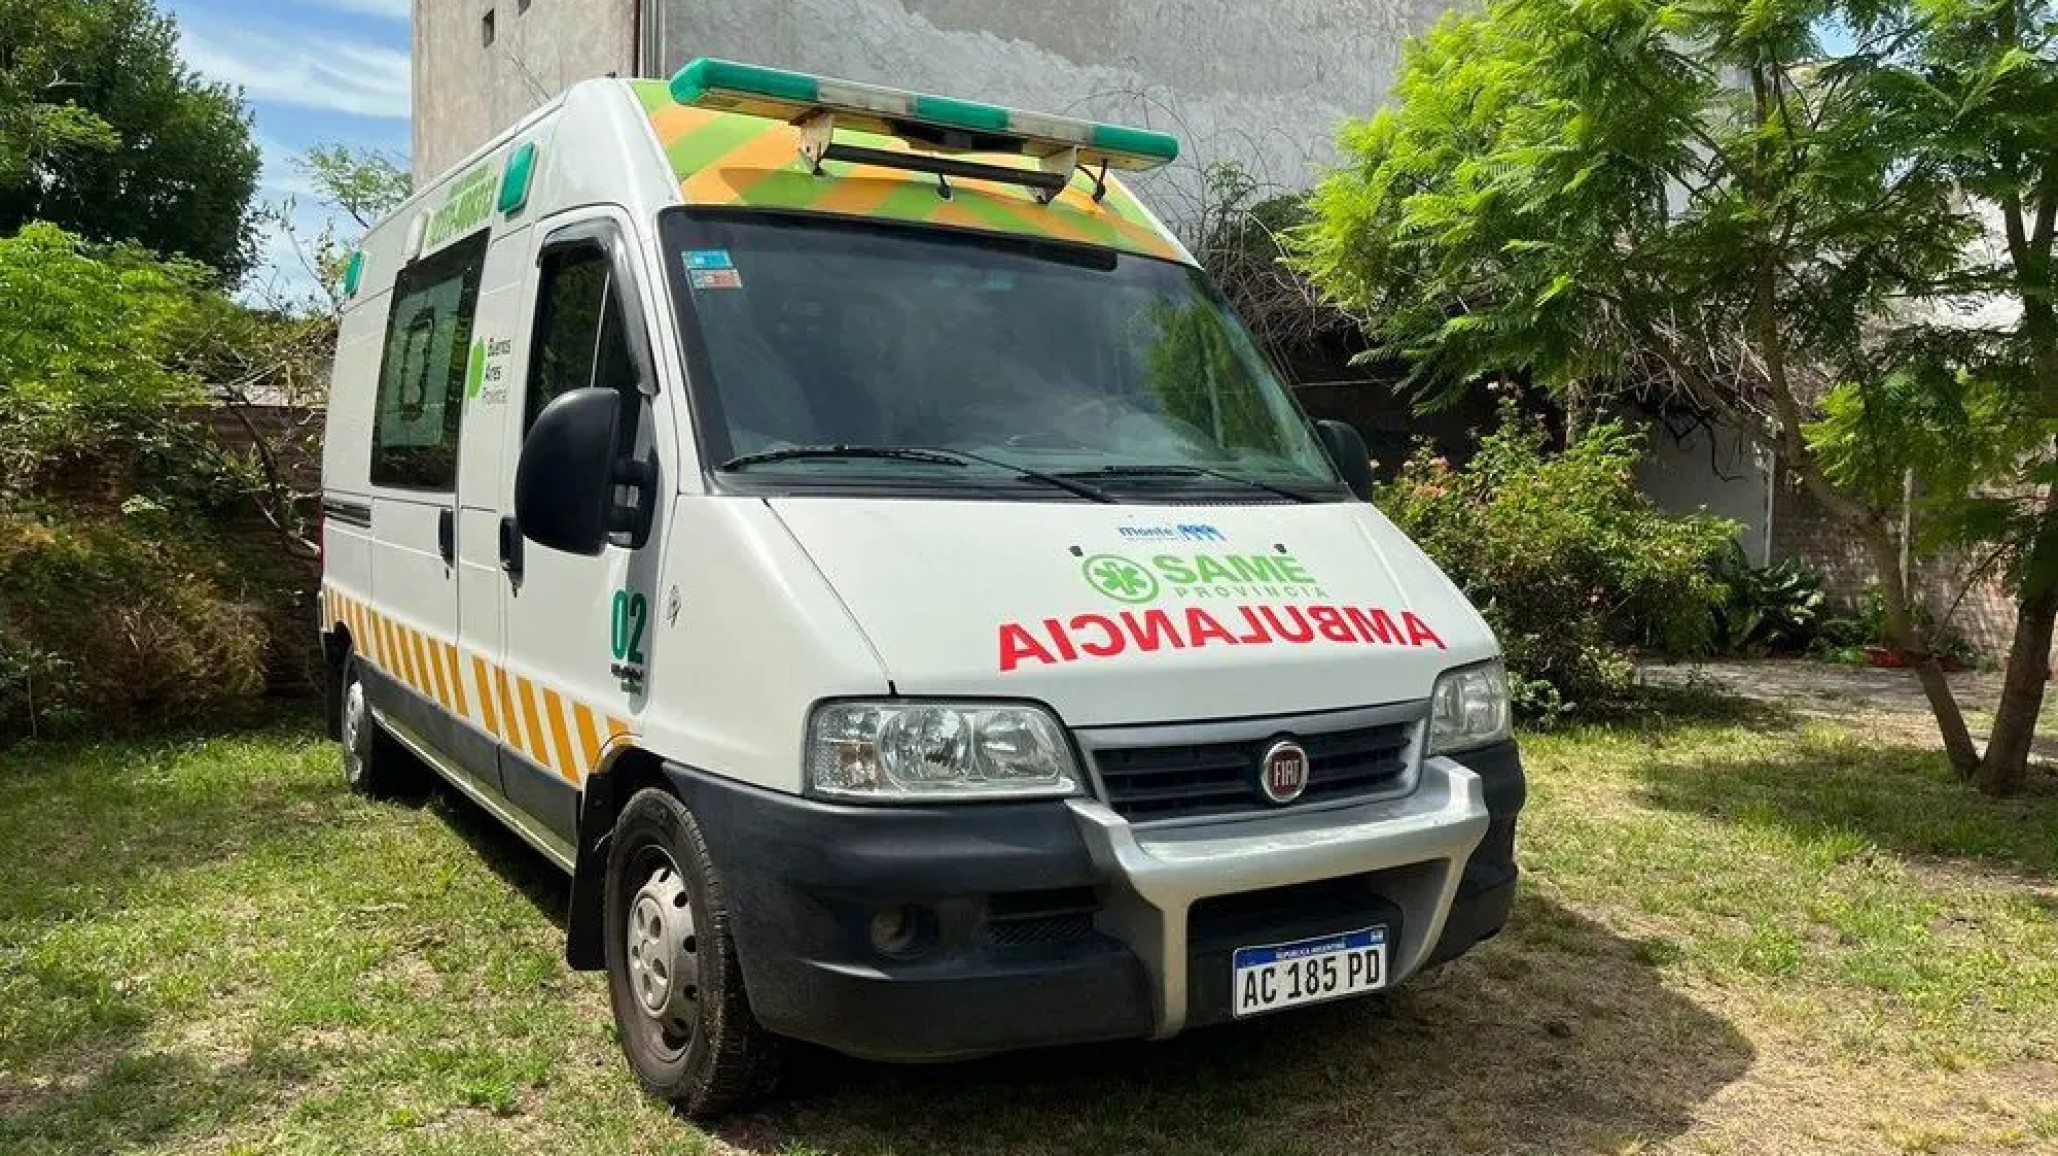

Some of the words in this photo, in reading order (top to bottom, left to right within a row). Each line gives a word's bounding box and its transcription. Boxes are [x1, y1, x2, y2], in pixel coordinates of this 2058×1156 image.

[1152, 554, 1315, 584] SAME
[1172, 585, 1330, 599] PROVINCIA
[612, 590, 647, 664] 02
[1274, 759, 1300, 788] FIAT
[1242, 967, 1276, 1008] AC
[1287, 956, 1337, 998] 185
[1348, 950, 1380, 987] PD
